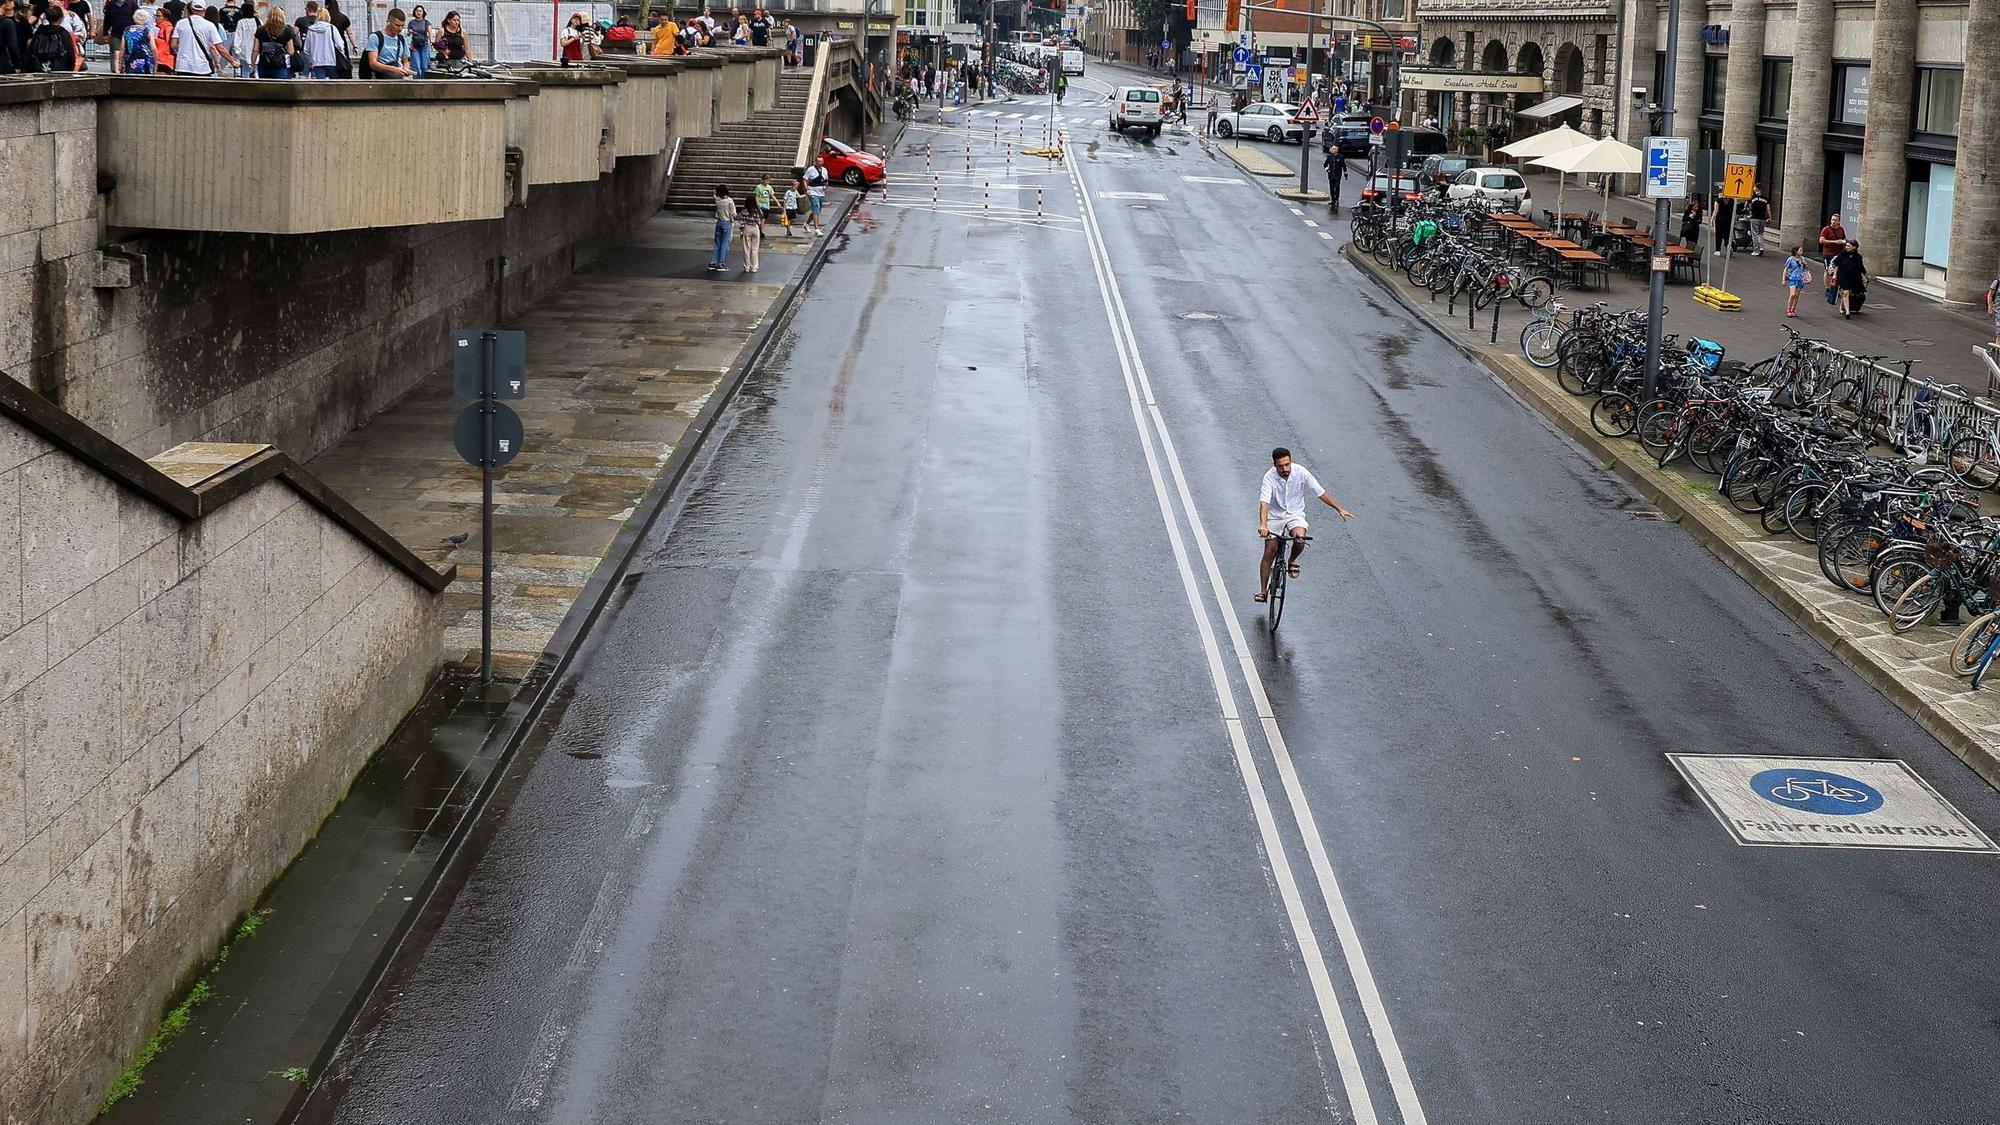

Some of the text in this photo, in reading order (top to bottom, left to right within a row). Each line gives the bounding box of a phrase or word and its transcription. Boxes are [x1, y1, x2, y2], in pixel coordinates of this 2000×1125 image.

[1443, 76, 1518, 89] Excelsior Hotel Ernst
[1730, 166, 1744, 176] U3
[1735, 819, 1968, 837] Fahrradstraße
